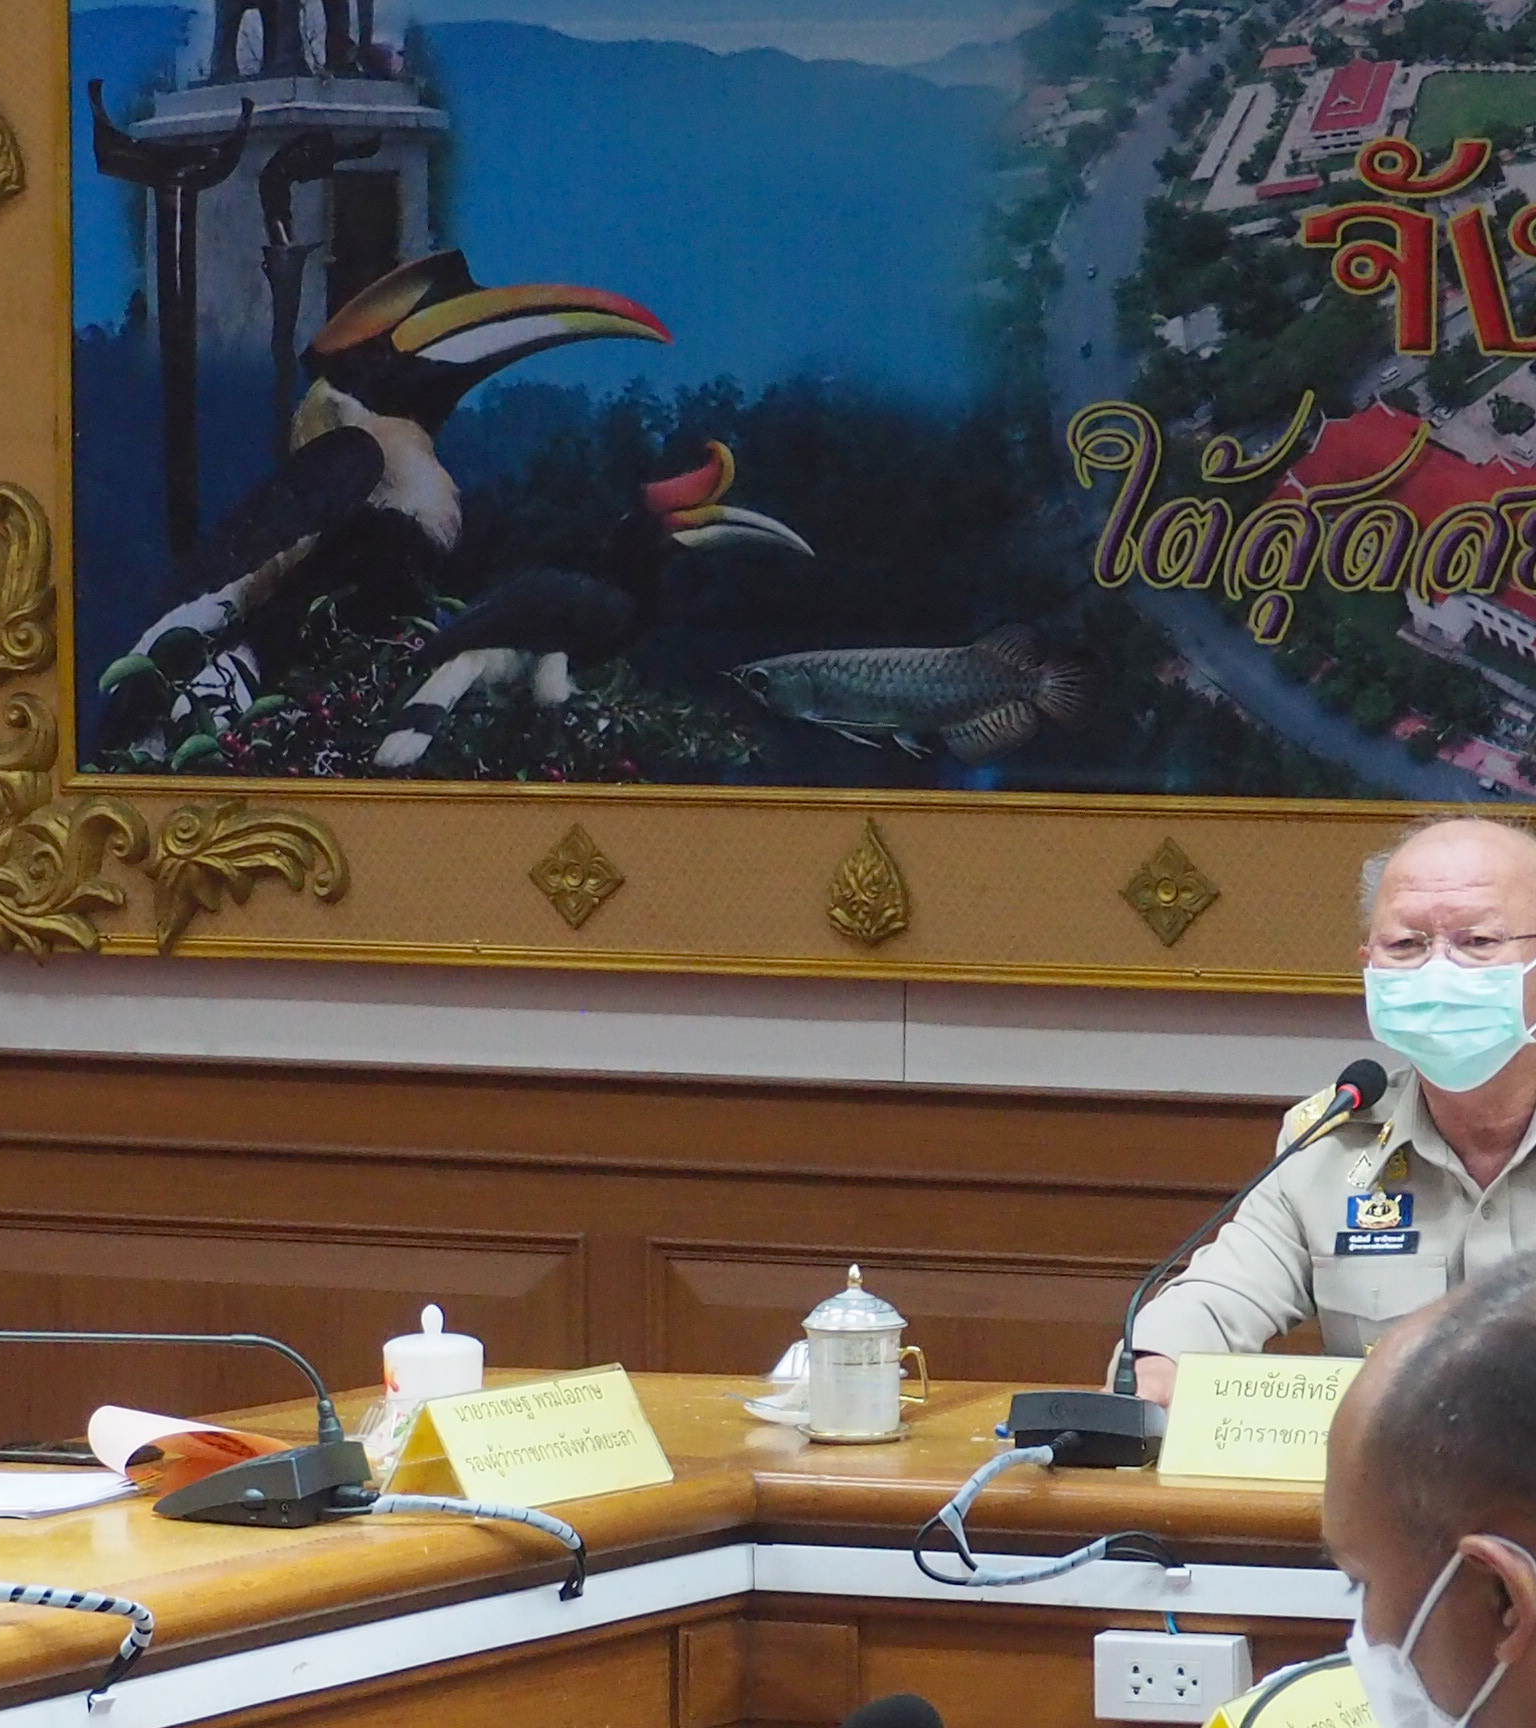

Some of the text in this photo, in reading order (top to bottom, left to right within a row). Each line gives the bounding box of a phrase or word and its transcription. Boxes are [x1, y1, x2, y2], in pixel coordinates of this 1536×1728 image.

[1213, 1367, 1344, 1402] นายชัยสิทธิ์
